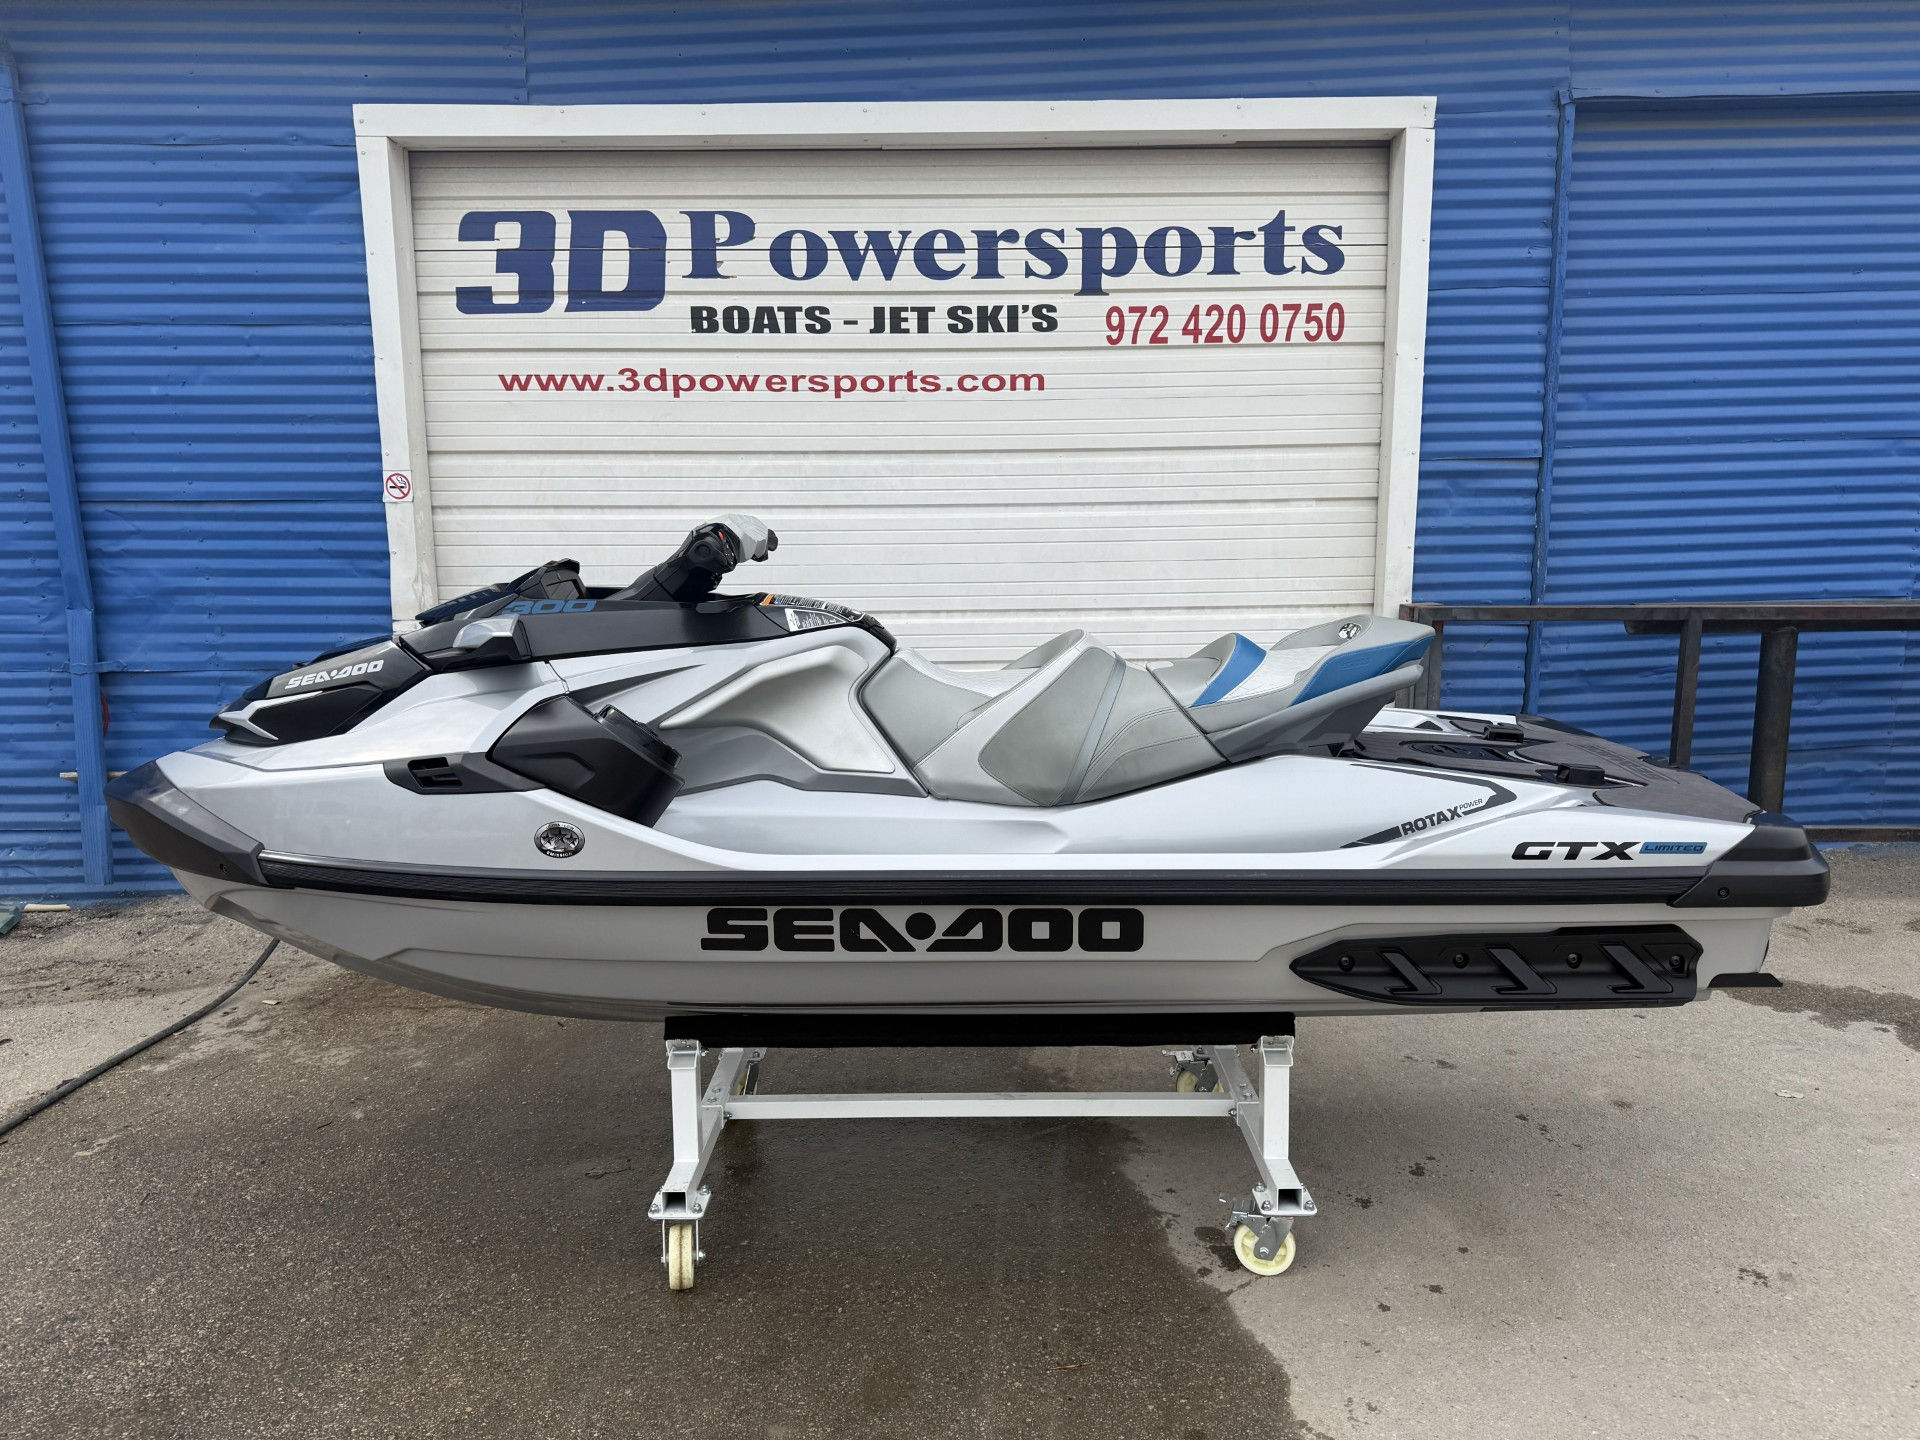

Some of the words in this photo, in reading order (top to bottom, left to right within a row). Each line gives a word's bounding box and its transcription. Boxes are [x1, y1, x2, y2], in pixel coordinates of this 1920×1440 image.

[456, 210, 667, 315] 3D
[679, 209, 1346, 296] Powersports
[690, 305, 832, 335] BOATS
[869, 306, 936, 335] JET
[946, 304, 1059, 334] SKI'S
[1105, 305, 1169, 346] 972
[1182, 303, 1246, 344] 420
[1260, 302, 1345, 343] 0750
[498, 367, 1046, 399] www.3dpowersports.com
[502, 599, 597, 616] 300
[1401, 806, 1462, 836] ROTAX
[1459, 798, 1483, 811] POWER
[1511, 841, 1642, 861] GTX
[1645, 844, 1703, 852] LIMITED
